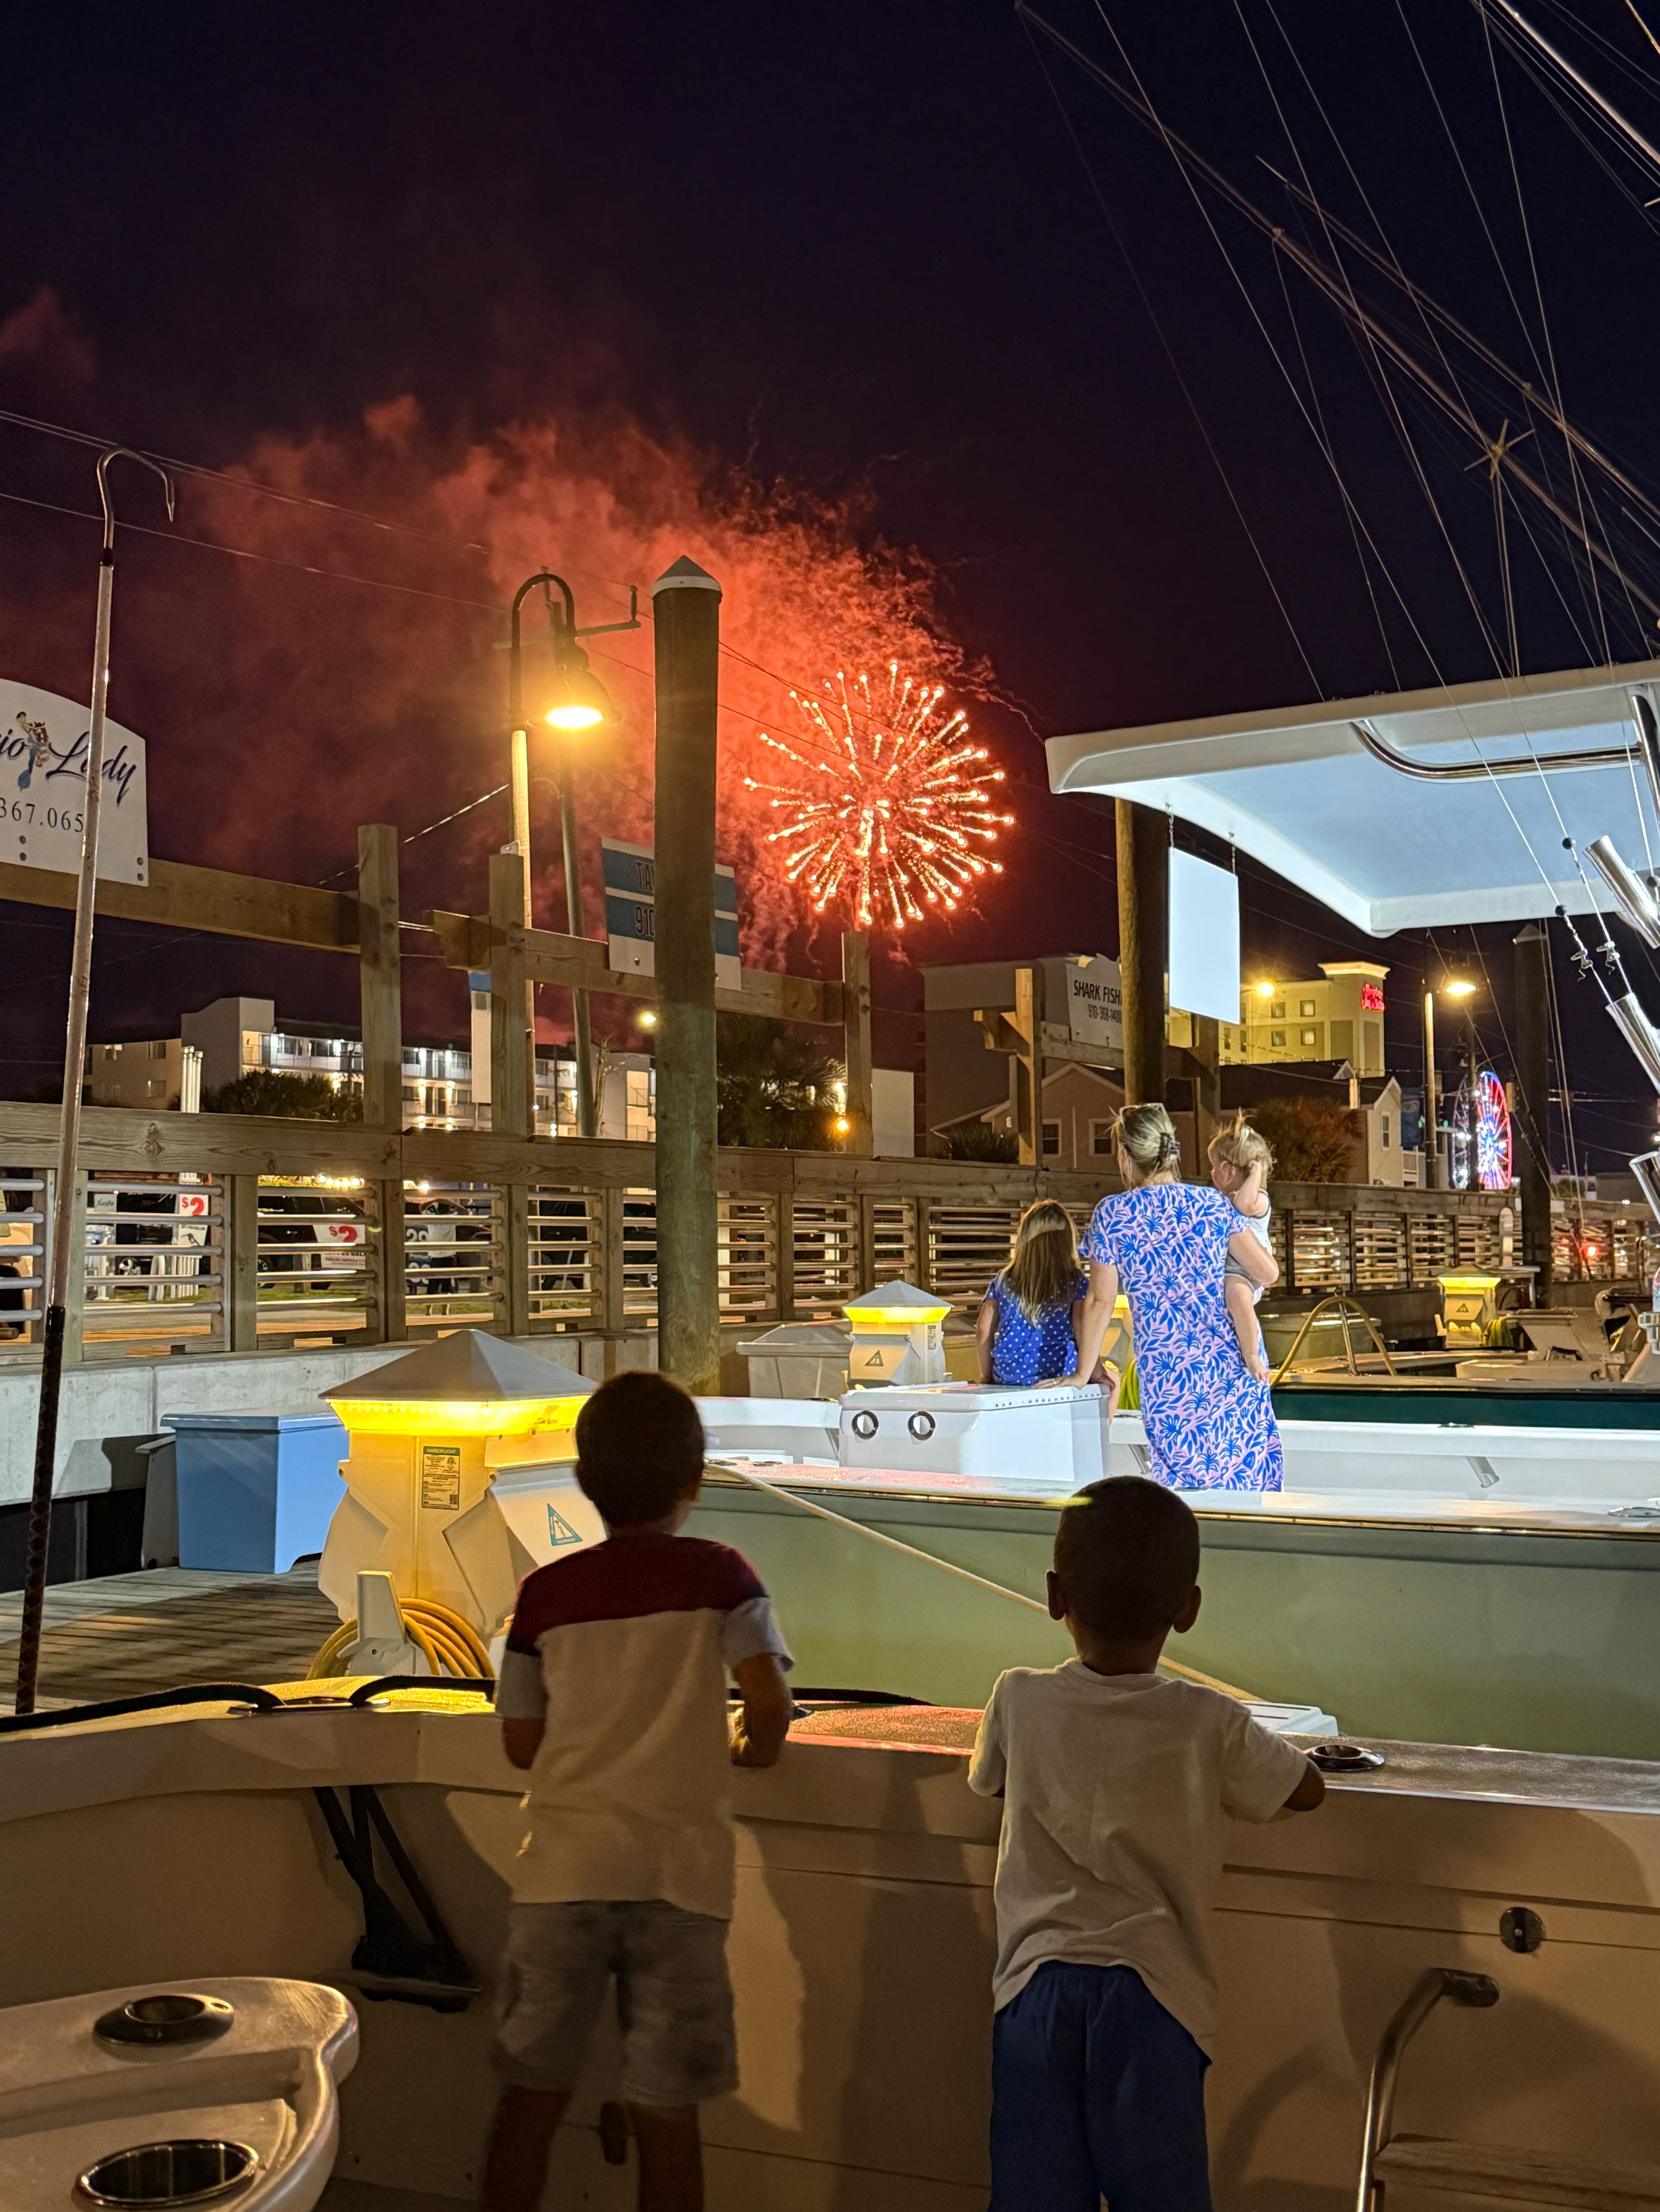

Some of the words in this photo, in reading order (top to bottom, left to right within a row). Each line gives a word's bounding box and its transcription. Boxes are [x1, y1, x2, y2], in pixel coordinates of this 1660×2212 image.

[0, 728, 29, 758] io
[636, 862, 654, 892] TA
[1073, 980, 1101, 1001] SHARK
